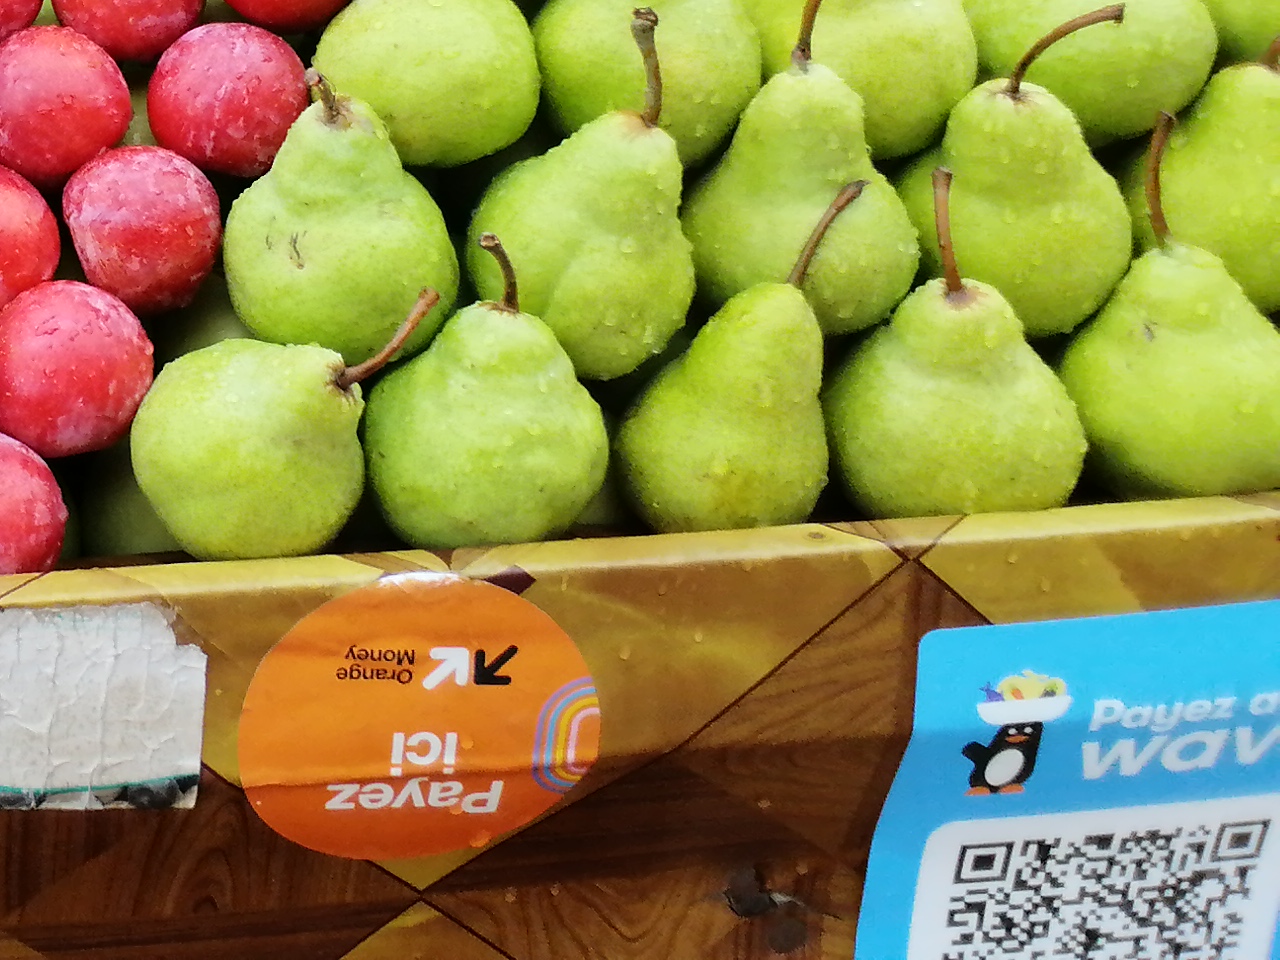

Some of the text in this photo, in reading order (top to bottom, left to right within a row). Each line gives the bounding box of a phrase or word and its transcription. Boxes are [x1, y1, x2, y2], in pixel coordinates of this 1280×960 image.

[344, 644, 416, 666] Money
[336, 666, 413, 684] Orange
[1088, 696, 1238, 733] Payez
[389, 732, 458, 777] ici
[1081, 725, 1280, 780] wav
[324, 778, 505, 814] Payez
